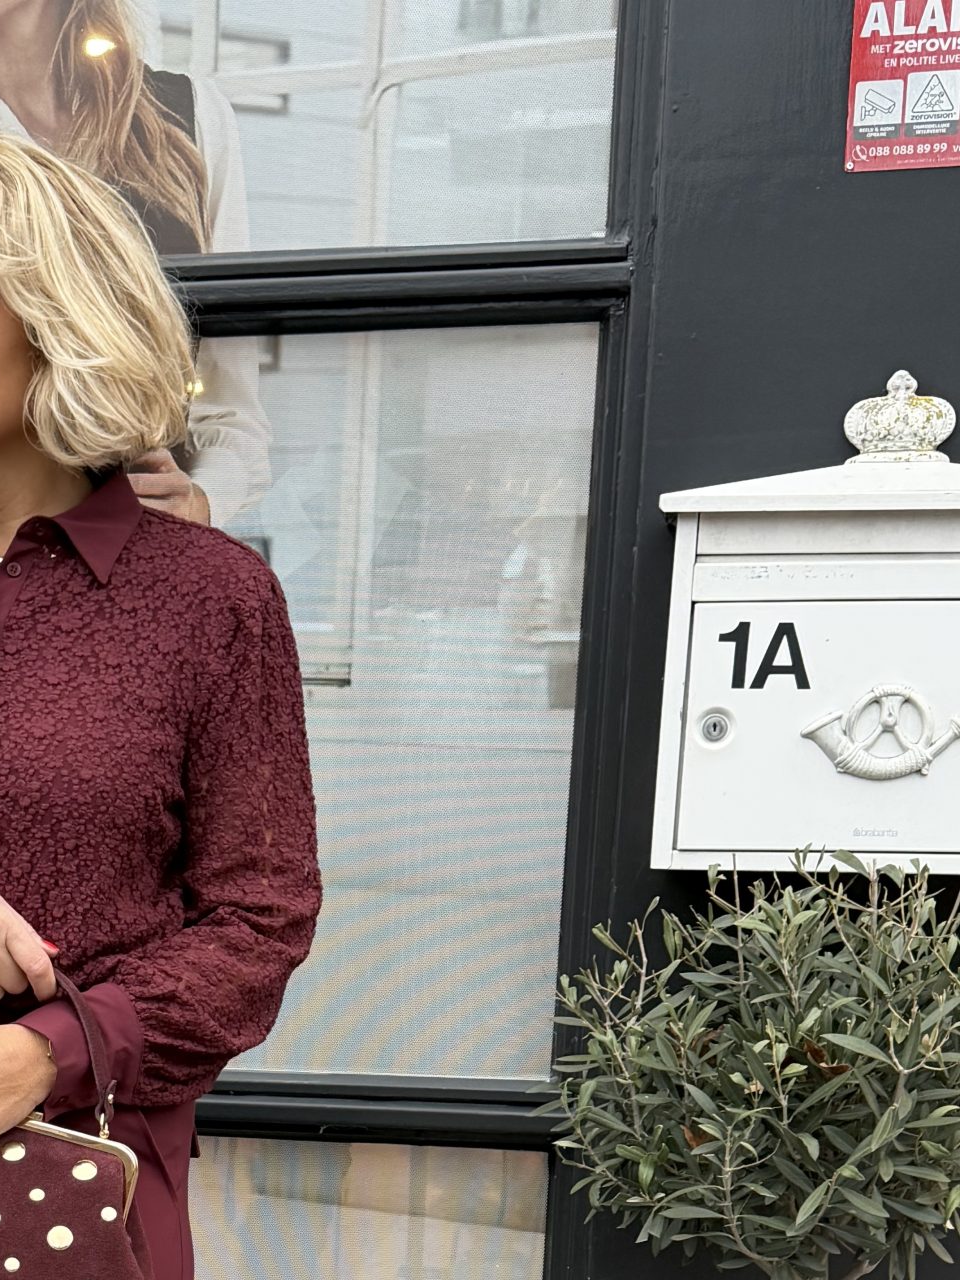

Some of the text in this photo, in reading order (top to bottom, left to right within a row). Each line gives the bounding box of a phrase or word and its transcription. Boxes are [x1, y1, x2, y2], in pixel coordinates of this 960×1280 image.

[871, 44, 891, 54] MET
[884, 54, 960, 68] EN POLITIE LIVE
[869, 146, 890, 157] 088
[893, 145, 914, 155] 088
[917, 144, 931, 154] 89
[933, 143, 947, 153] 99
[718, 621, 811, 689] 1A
